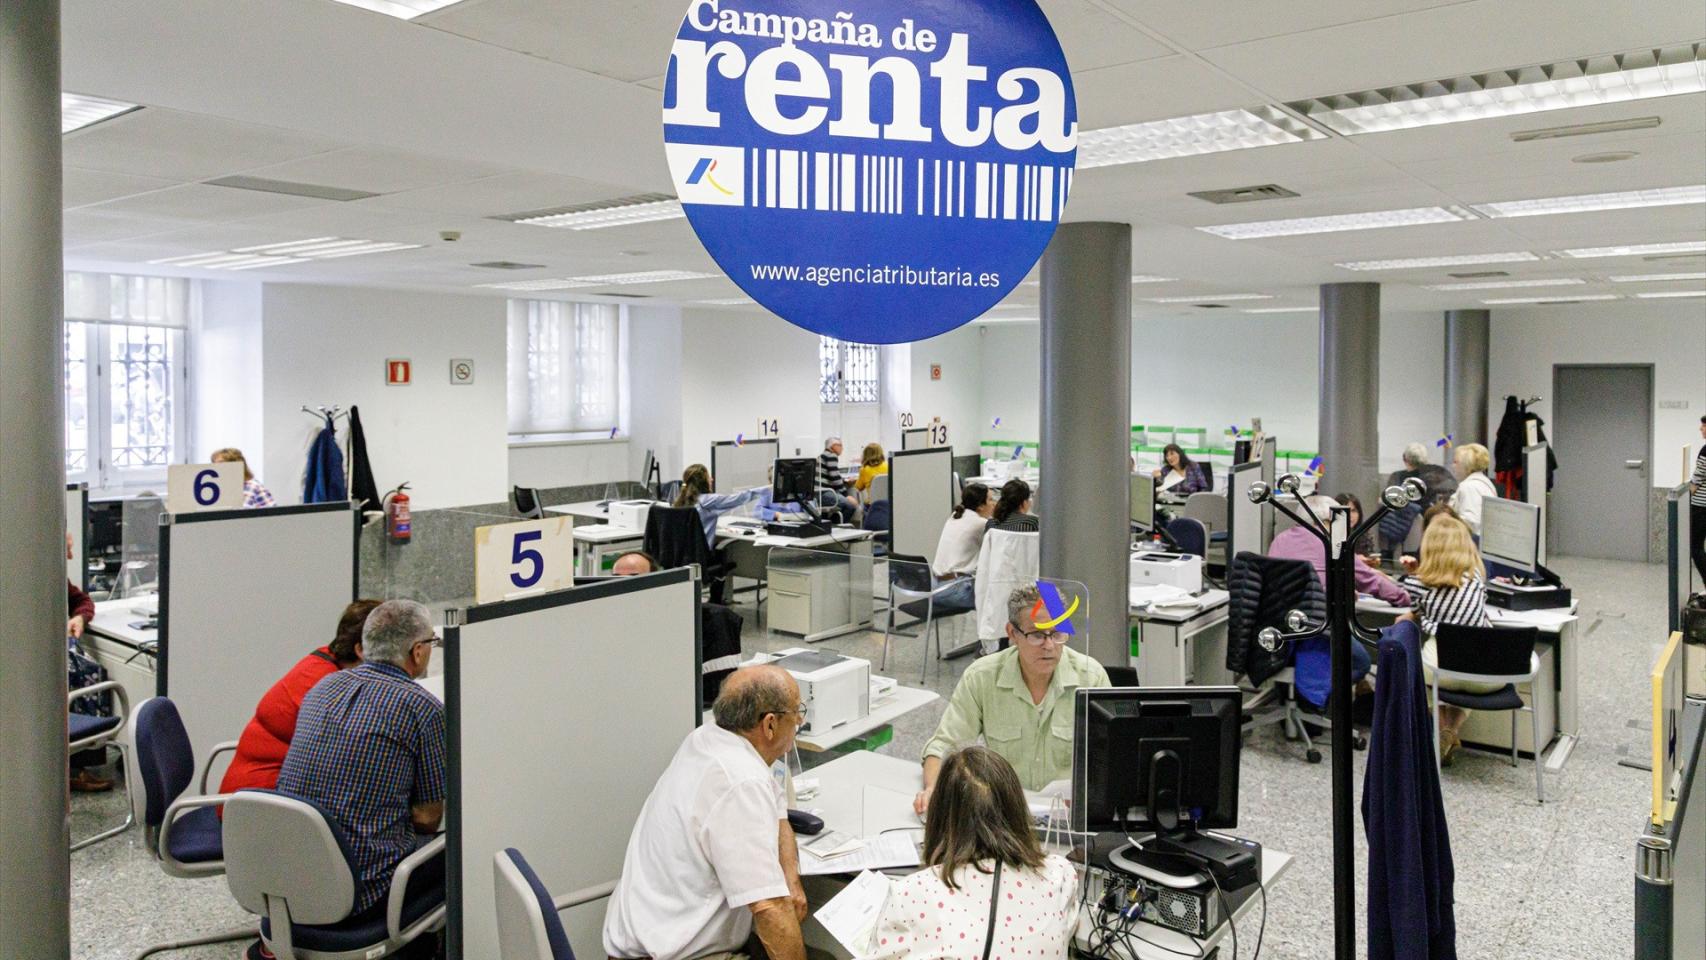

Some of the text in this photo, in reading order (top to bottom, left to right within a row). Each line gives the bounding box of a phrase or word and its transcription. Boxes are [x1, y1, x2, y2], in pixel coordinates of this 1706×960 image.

[687, 0, 937, 52] Campaña de
[663, 33, 1077, 153] renta
[751, 264, 1000, 287] www.agenciatributaria.es
[762, 419, 778, 436] 14
[901, 412, 913, 427] 20
[931, 425, 947, 445] 13
[194, 469, 220, 506] 6
[510, 530, 544, 588] 5
